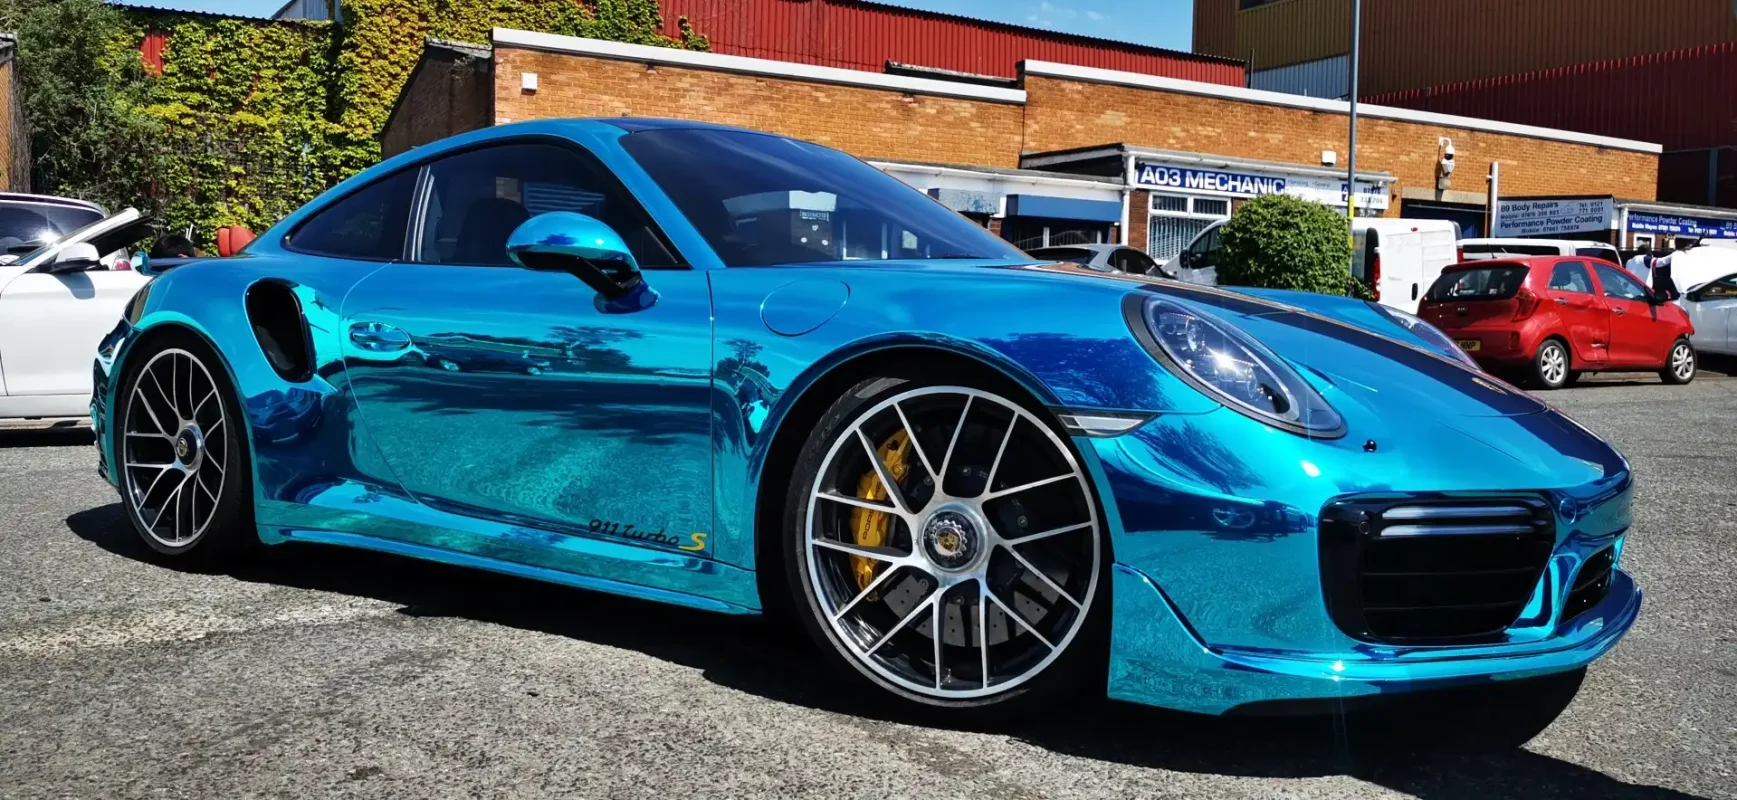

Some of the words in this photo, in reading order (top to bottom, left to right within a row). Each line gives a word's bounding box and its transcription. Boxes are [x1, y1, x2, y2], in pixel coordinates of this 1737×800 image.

[1185, 171, 1285, 195] MECHANIC
[1512, 203, 1530, 211] Body
[1533, 202, 1559, 210] Repairs
[1501, 220, 1544, 229] Performance
[1546, 216, 1573, 225] Powder
[1574, 215, 1603, 223] Coating
[1628, 213, 1658, 223] erformance
[1659, 216, 1678, 225] Powder
[1679, 218, 1697, 227] Coating
[589, 519, 619, 535] 911
[678, 532, 707, 551] S
